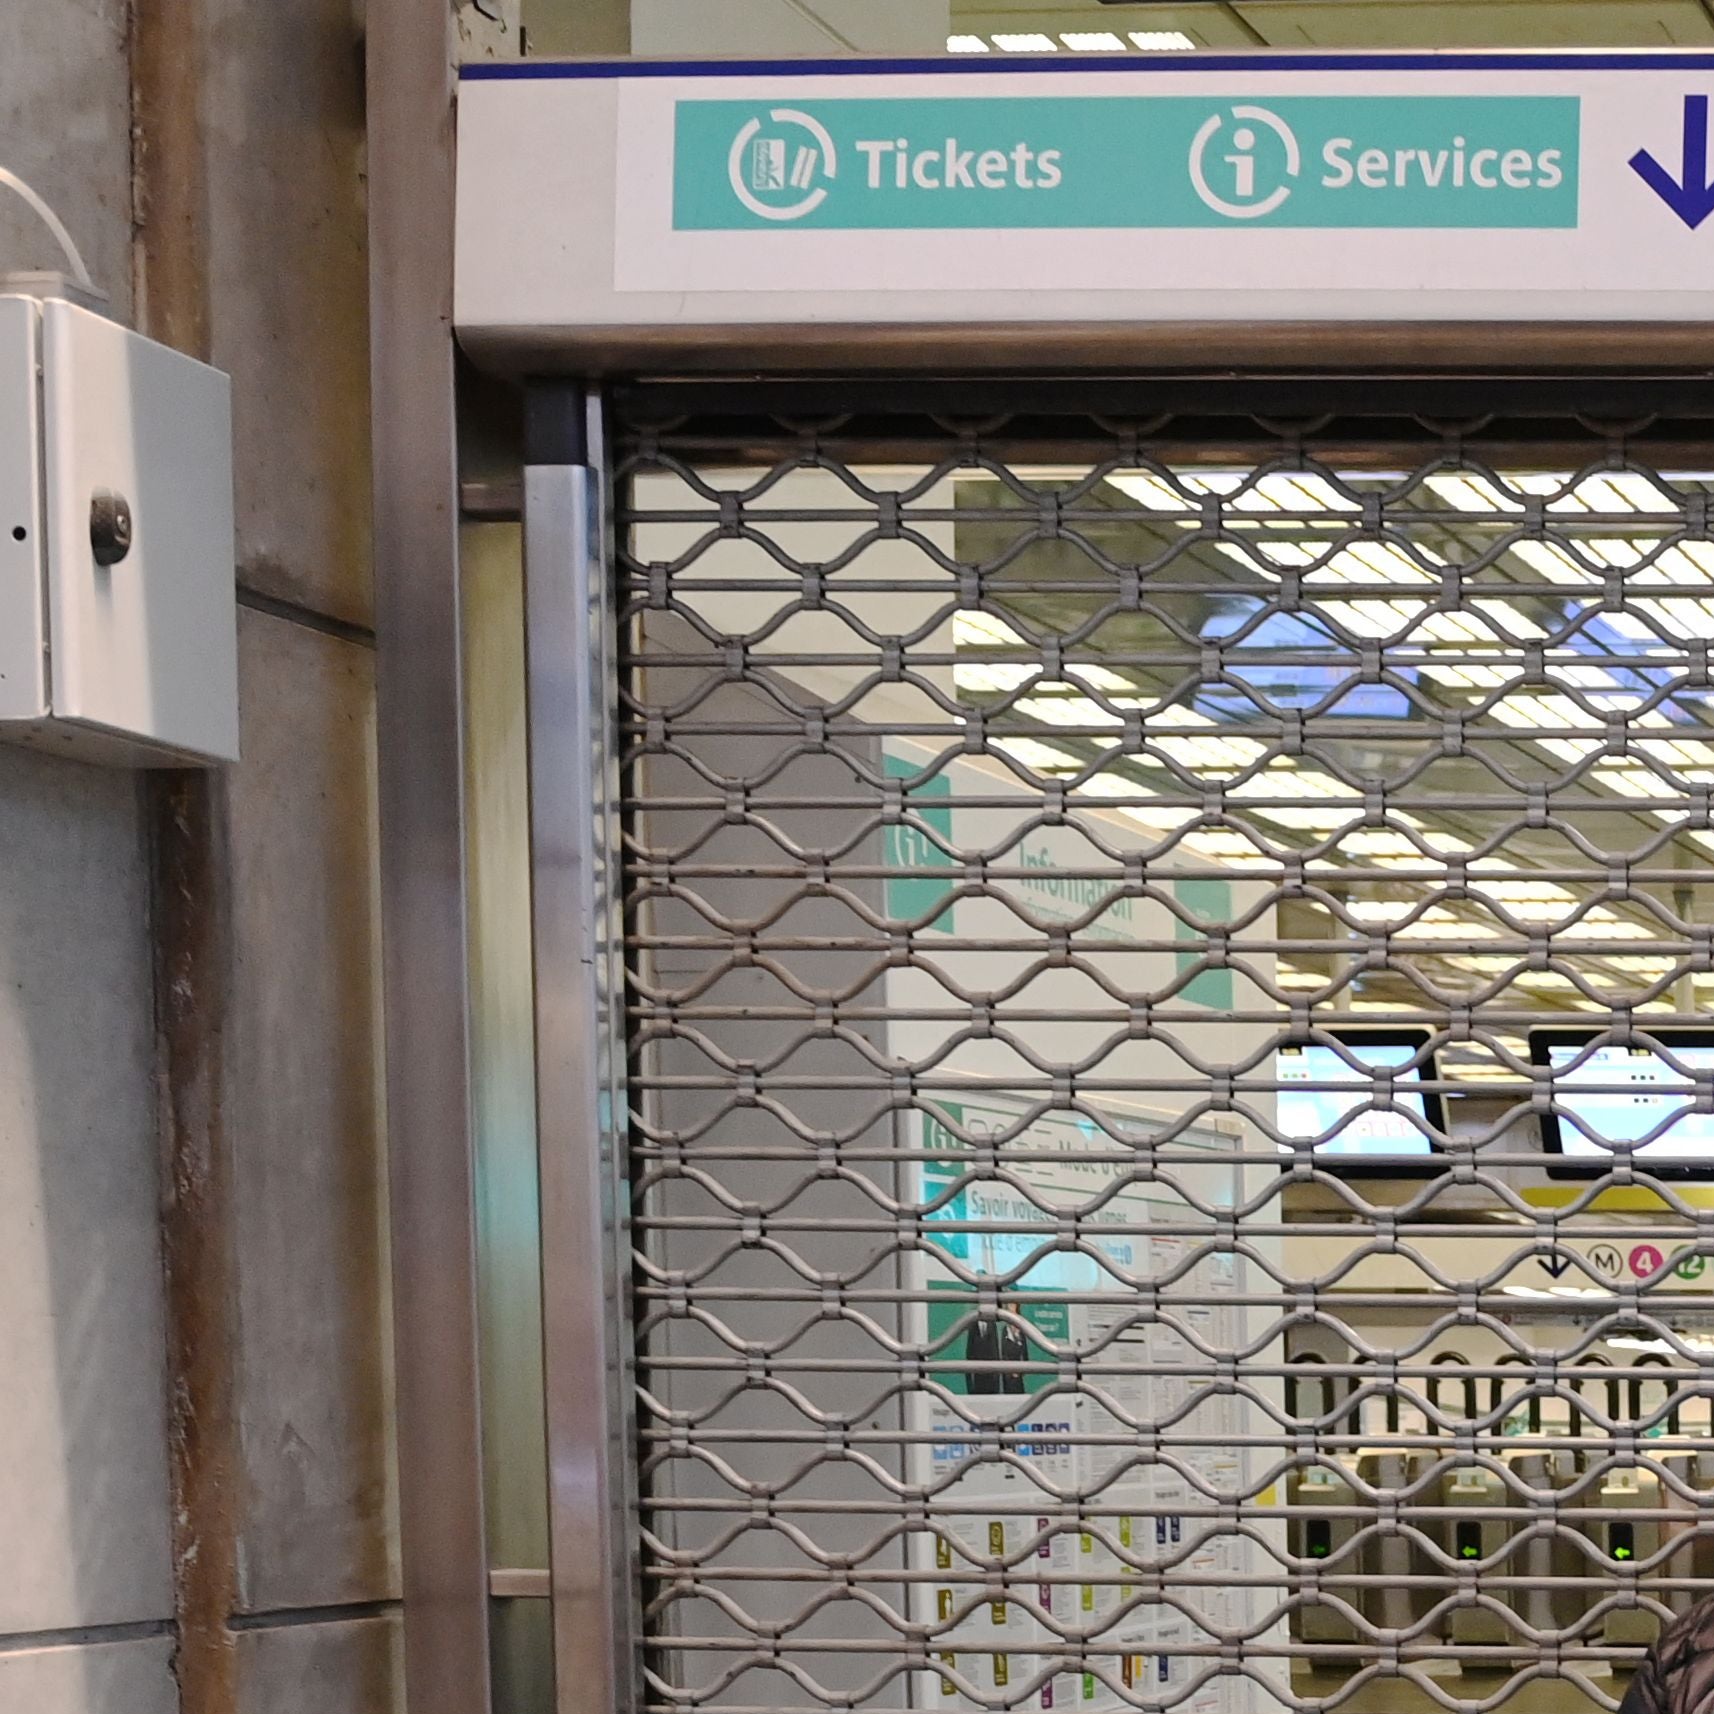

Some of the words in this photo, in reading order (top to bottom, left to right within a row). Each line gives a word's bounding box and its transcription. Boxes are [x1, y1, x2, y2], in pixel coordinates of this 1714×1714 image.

[855, 137, 1063, 190] Tickets
[1320, 136, 1564, 190] Services
[970, 1189, 1010, 1218] Savoir
[1594, 1259, 1616, 1272] M
[1635, 1251, 1655, 1274] 4
